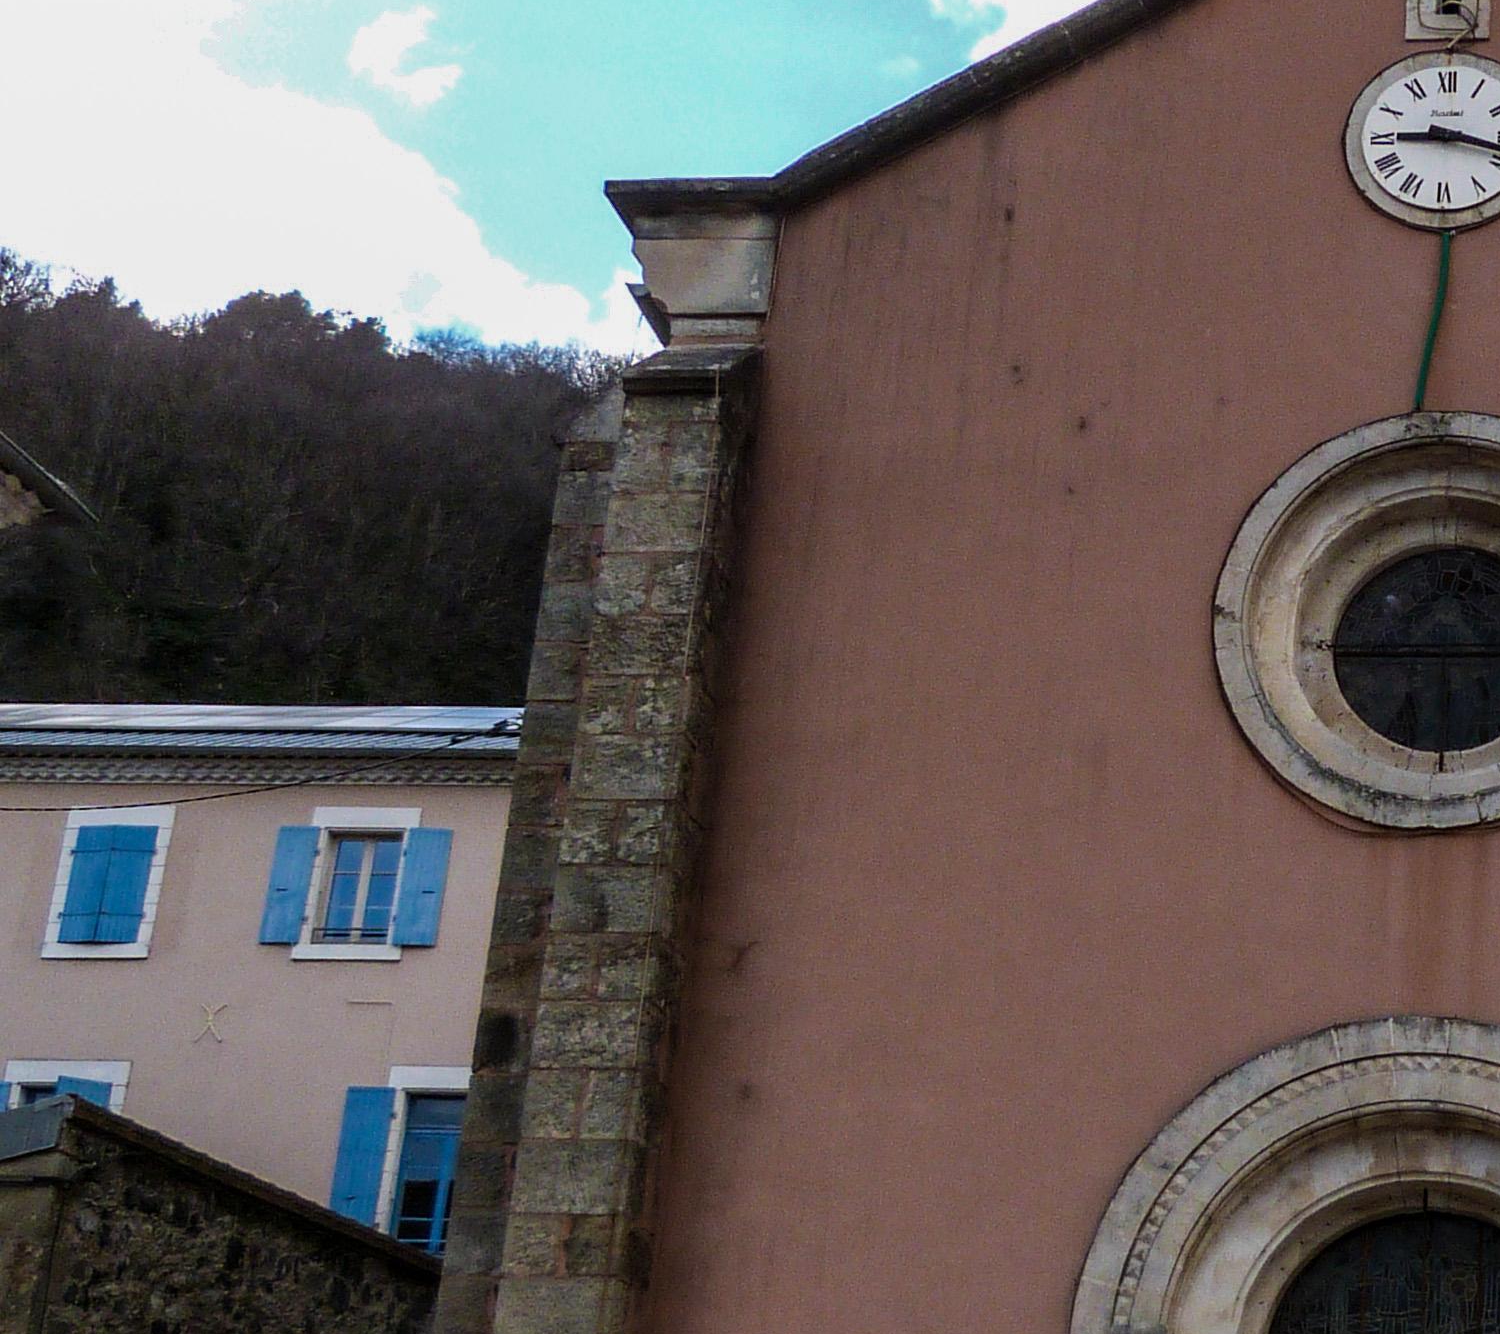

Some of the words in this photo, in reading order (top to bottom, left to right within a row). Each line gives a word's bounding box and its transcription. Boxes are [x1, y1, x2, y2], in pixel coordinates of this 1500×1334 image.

[1404, 78, 1427, 102] XI
[1438, 71, 1457, 93] XII
[1379, 103, 1403, 120] X
[1399, 172, 1424, 198] VII
[1437, 182, 1451, 203] VI
[1471, 176, 1486, 200] V
